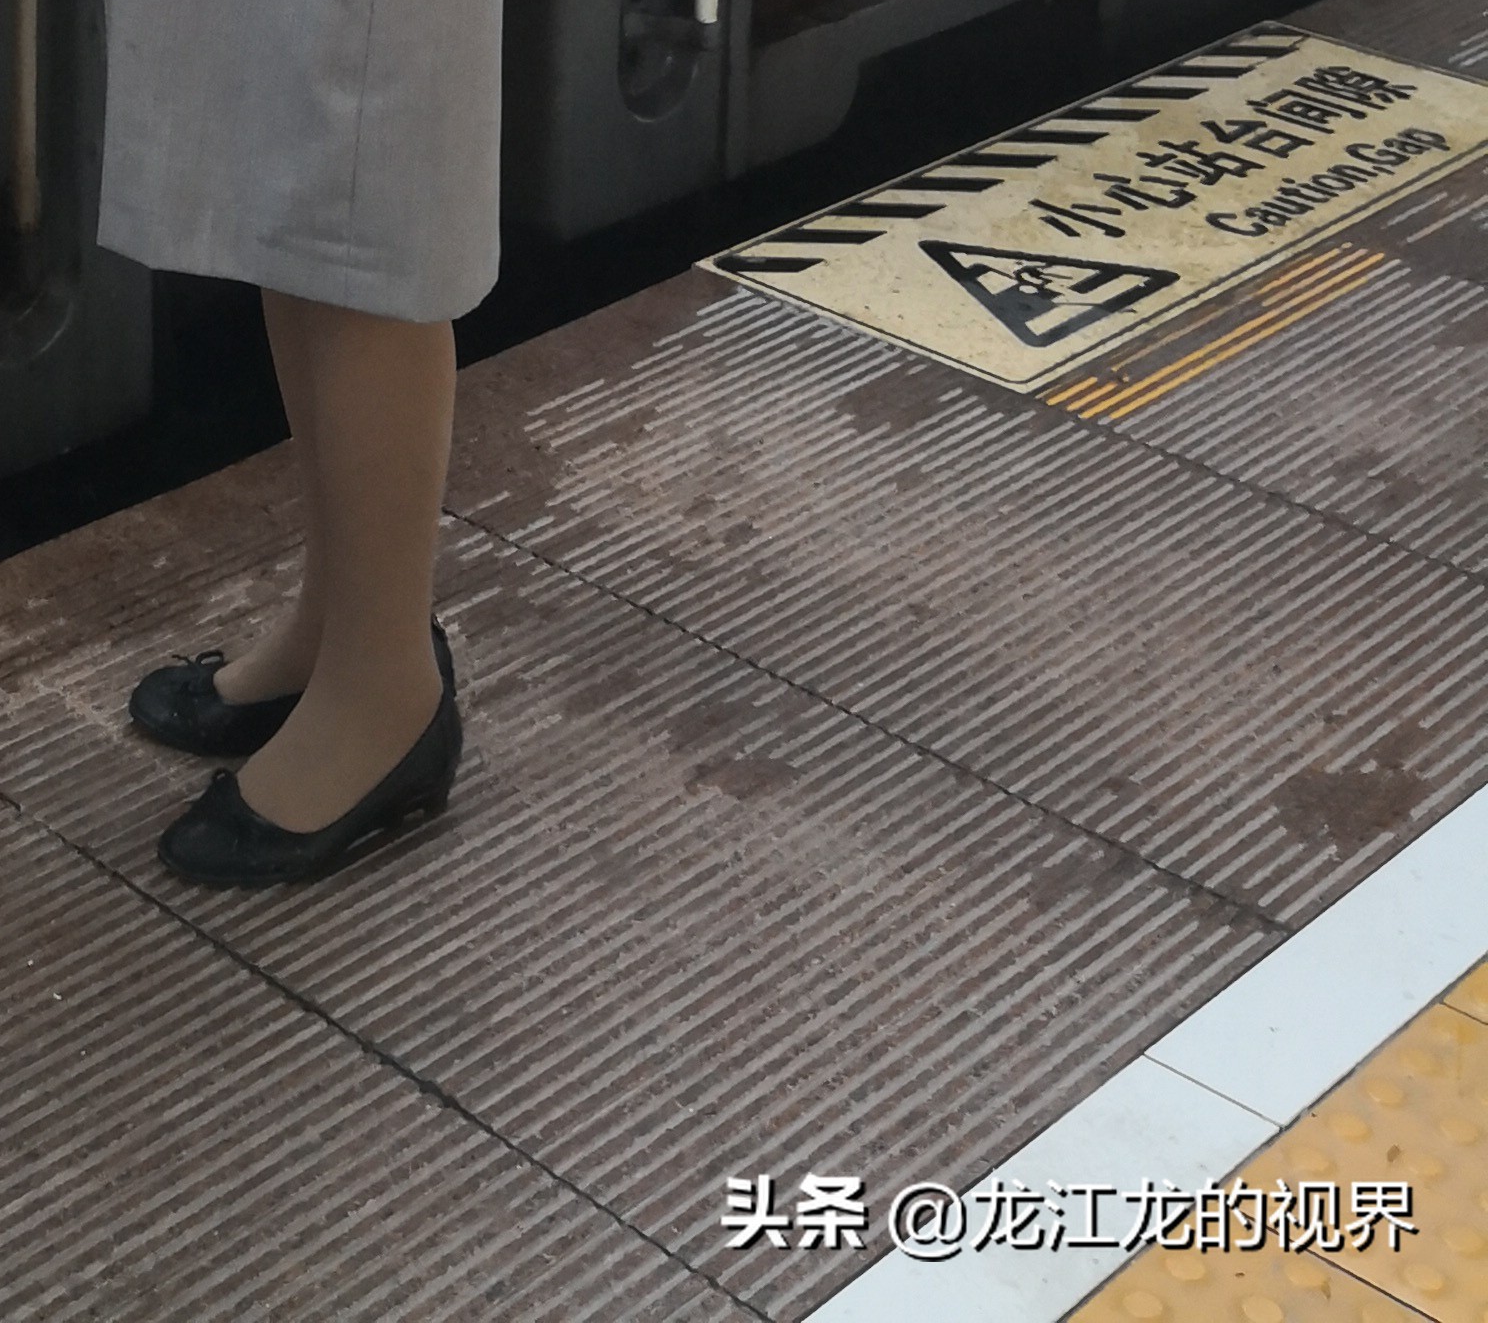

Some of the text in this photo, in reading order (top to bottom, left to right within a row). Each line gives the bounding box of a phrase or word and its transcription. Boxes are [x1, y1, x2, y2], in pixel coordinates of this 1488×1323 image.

[1029, 66, 1417, 238] 小心站台间隙
